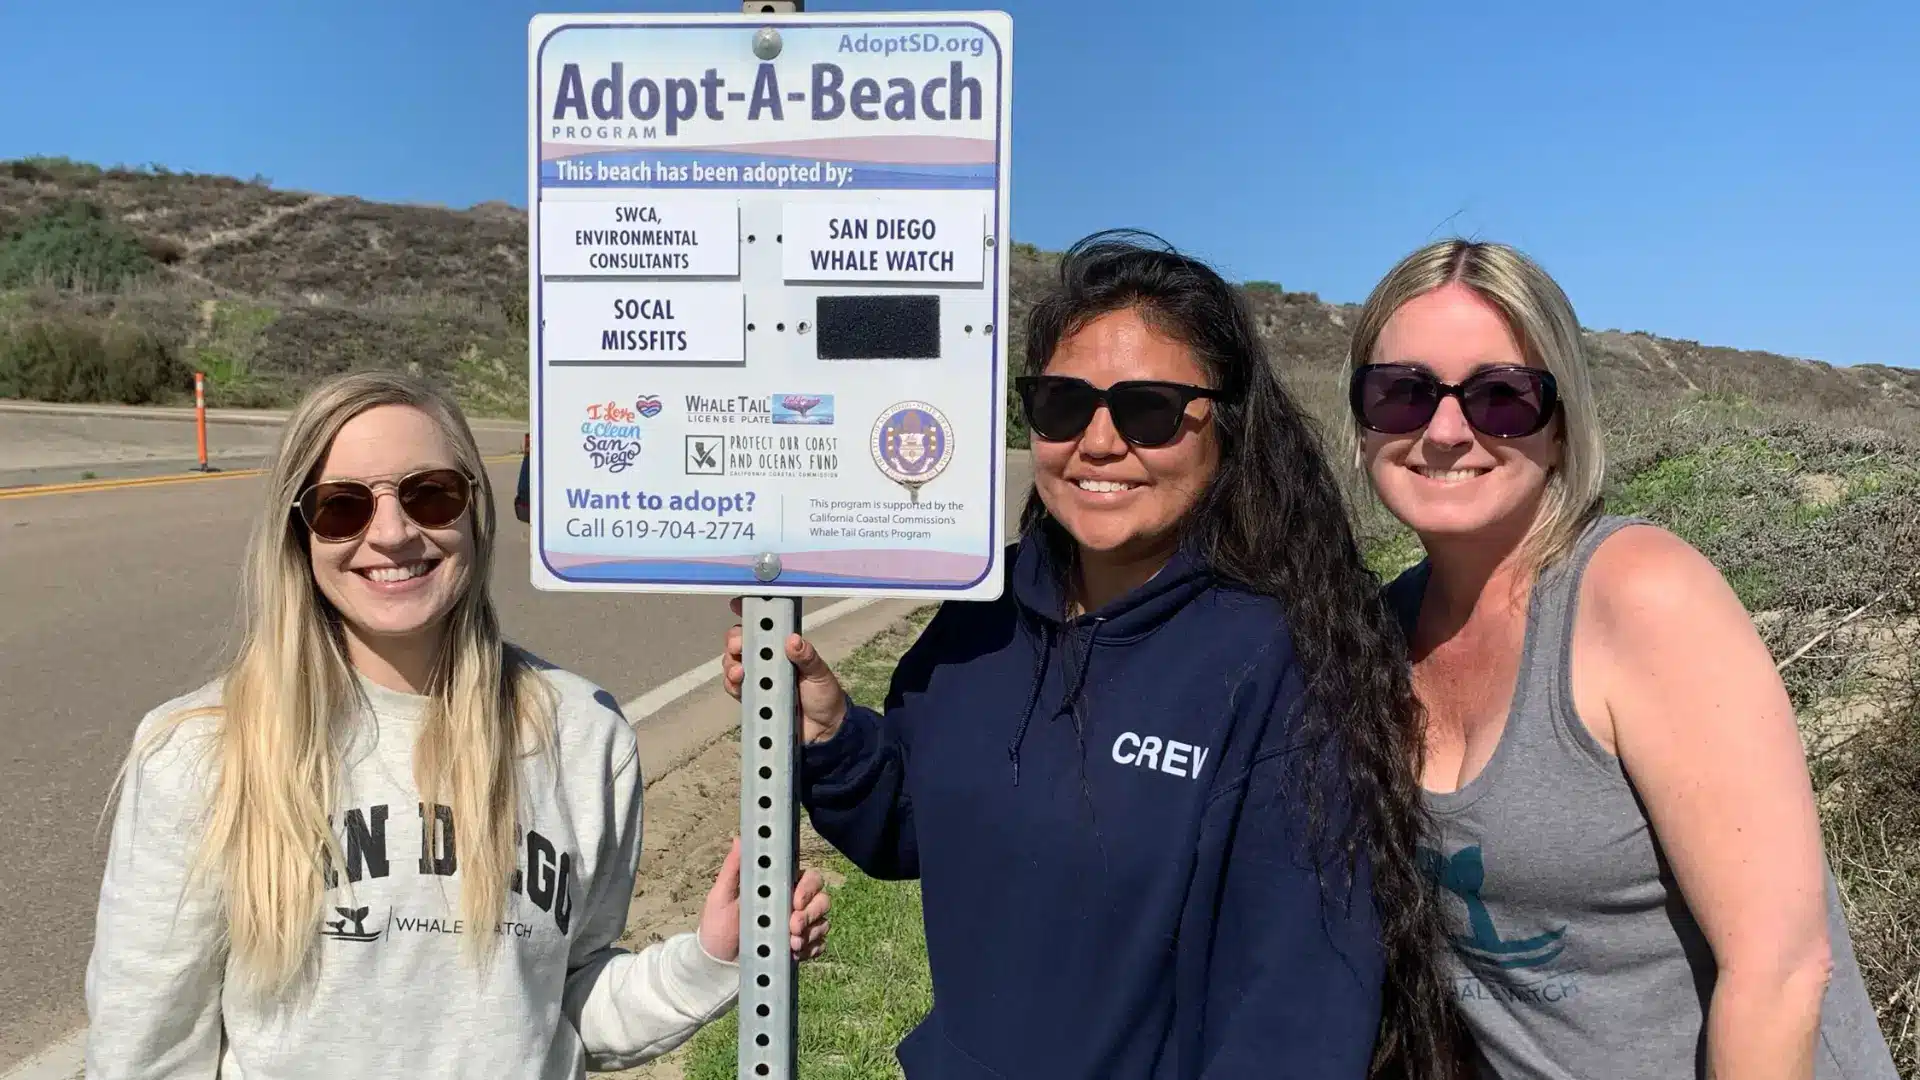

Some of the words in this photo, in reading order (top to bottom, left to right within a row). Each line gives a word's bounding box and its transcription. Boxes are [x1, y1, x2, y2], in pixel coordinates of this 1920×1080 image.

[838, 34, 984, 56] AdoptSD.org
[553, 61, 983, 136] Adopt-A-Beach
[552, 126, 657, 139] PROGRAM
[556, 160, 593, 181] This
[597, 160, 651, 181] beach
[656, 161, 688, 182] has
[693, 162, 739, 182] been
[742, 162, 821, 187] adopted
[826, 163, 853, 188] by:
[615, 207, 662, 224] SWCA,
[575, 230, 699, 246] ENVIRONMENTAL
[829, 218, 868, 240] SAN
[876, 218, 937, 240] DIEGO
[589, 253, 689, 269] CONSULTANTS
[810, 250, 879, 271] WHALE
[886, 250, 954, 272] WATCH
[613, 299, 675, 320] SOCAL
[601, 330, 688, 351] MISSFITS
[586, 404, 602, 420] I
[604, 401, 636, 423] Love
[685, 395, 735, 412] WHALE
[738, 396, 771, 413] TAIL
[688, 415, 735, 423] LICENSE
[741, 416, 770, 424] PLATE
[583, 435, 630, 452] San
[730, 435, 773, 450] PROTECT
[779, 436, 799, 450] OUR
[805, 436, 838, 451] COAST
[590, 441, 641, 473] Diego
[730, 454, 752, 469] AND
[759, 454, 801, 470] OCEANS
[810, 454, 838, 470] FUND
[566, 488, 630, 510] Want
[637, 491, 663, 511] to
[669, 489, 756, 517] adopt?
[810, 499, 829, 509] This
[831, 501, 871, 511] program
[874, 500, 881, 509] is
[883, 500, 932, 511] supported
[934, 500, 946, 511] by
[948, 501, 964, 511] the
[810, 513, 854, 523] California
[856, 514, 890, 524] Coastal
[892, 514, 956, 524] Commission's
[566, 517, 605, 538] Call
[612, 519, 755, 540] 619-704-2774
[810, 528, 839, 537] Whale
[841, 528, 856, 537] Tail
[858, 528, 889, 538] Grants
[891, 529, 931, 540] Program
[395, 917, 464, 934] WHALE
[477, 920, 533, 939] ATCH
